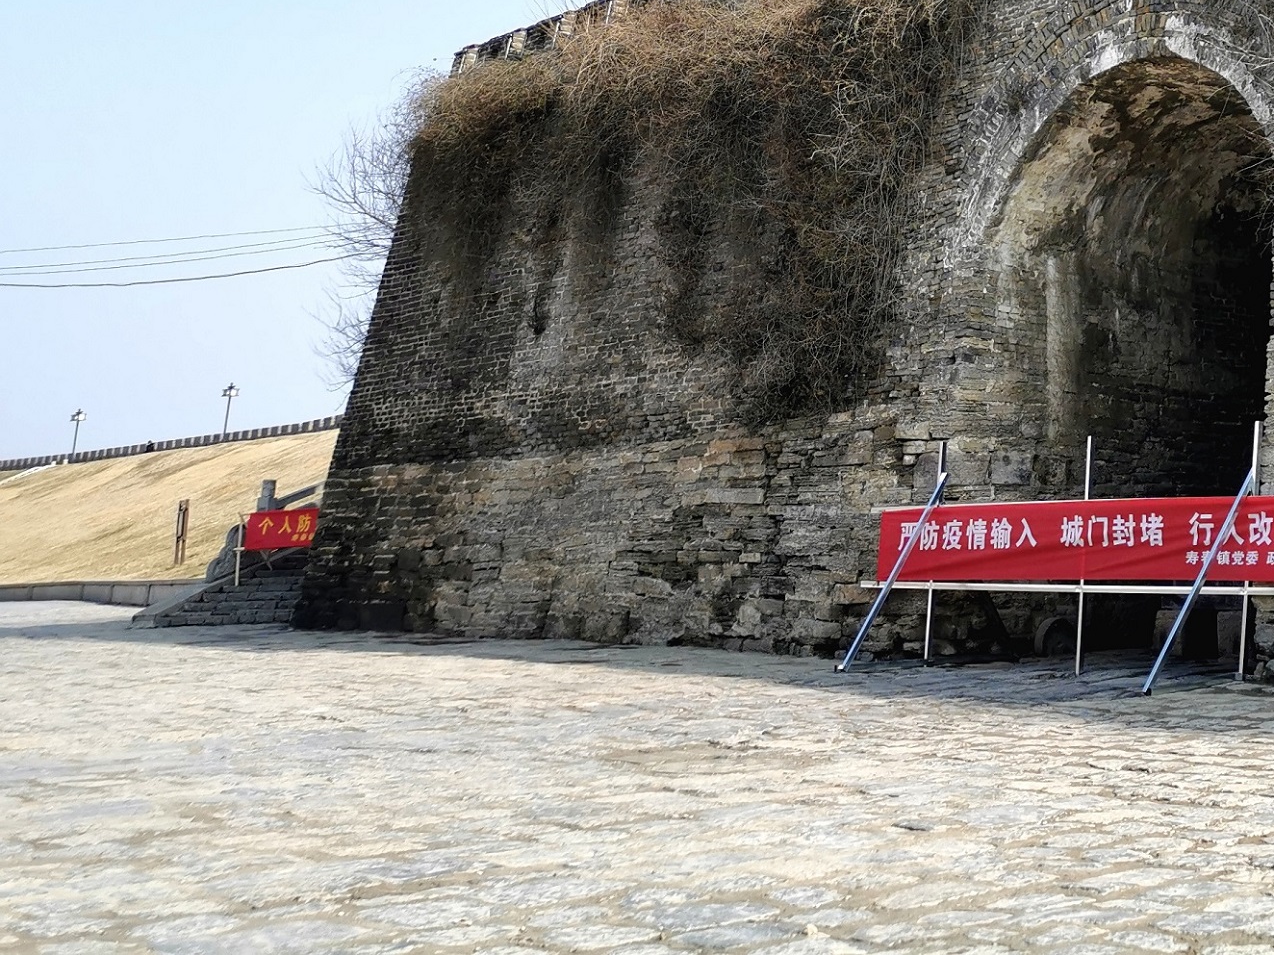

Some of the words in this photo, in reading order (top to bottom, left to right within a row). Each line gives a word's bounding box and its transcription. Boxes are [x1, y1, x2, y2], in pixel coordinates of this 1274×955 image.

[898, 517, 1037, 551] 严防疫情输入
[1060, 512, 1164, 547] 城门封堵
